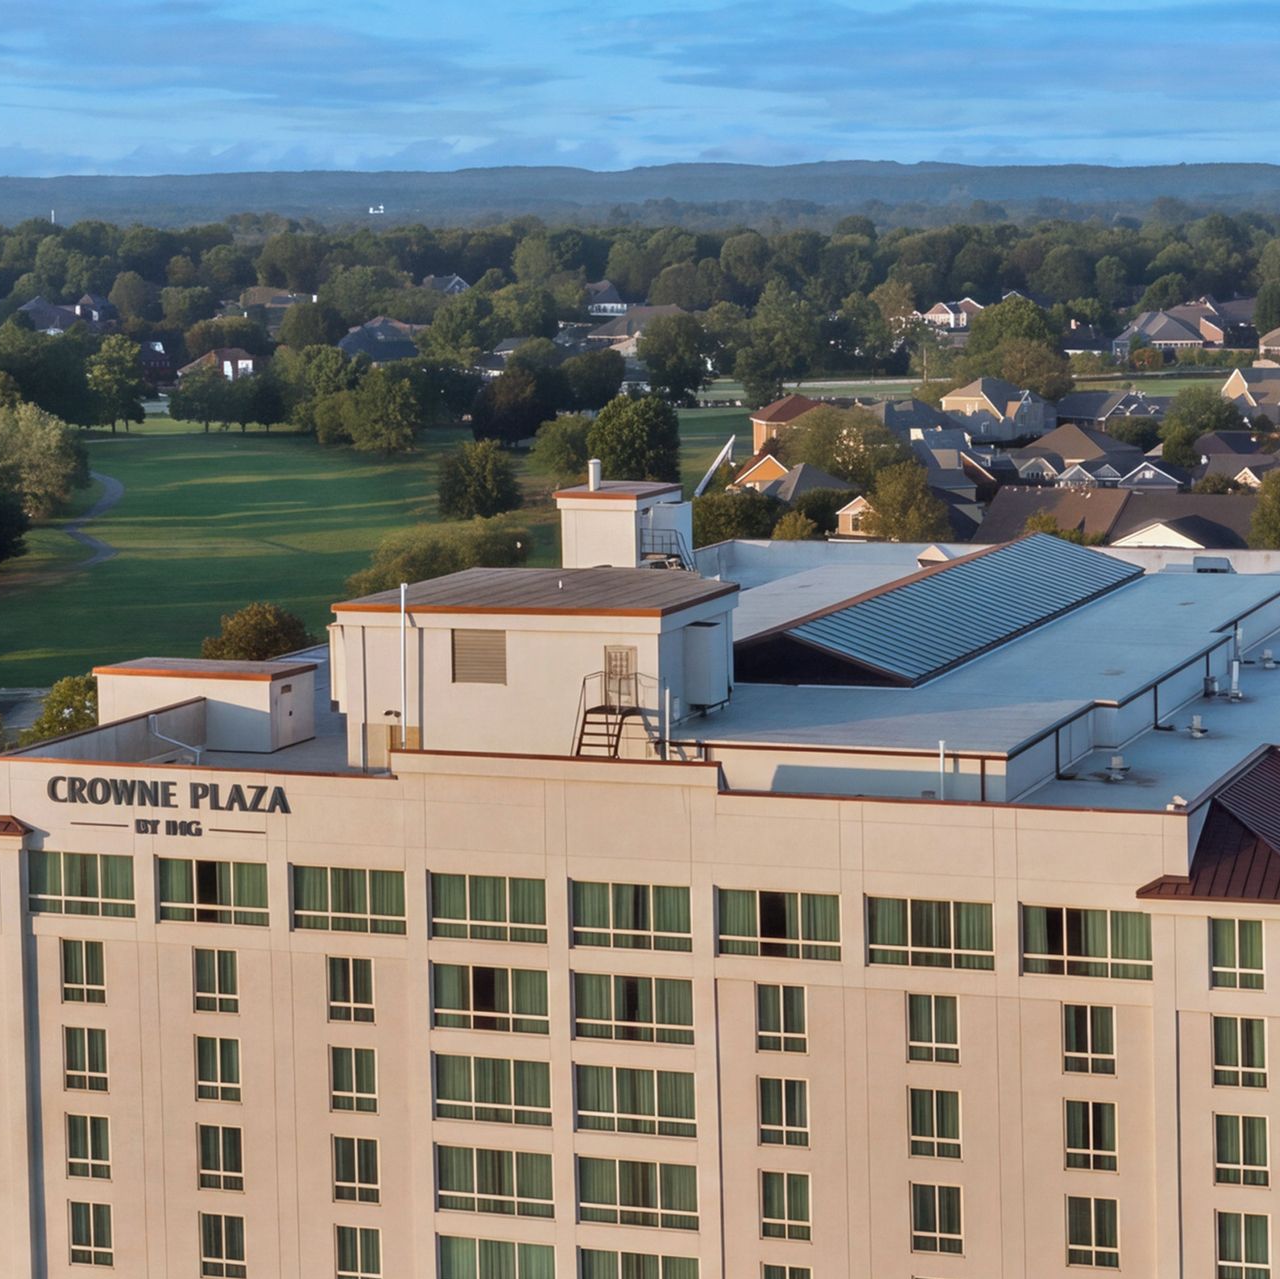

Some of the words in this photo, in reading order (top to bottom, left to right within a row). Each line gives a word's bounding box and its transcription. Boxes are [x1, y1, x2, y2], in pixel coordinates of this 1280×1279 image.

[47, 776, 178, 808] CROWNE
[189, 782, 291, 814] PLAZA
[135, 819, 160, 834] BY
[165, 820, 203, 836] IHG
